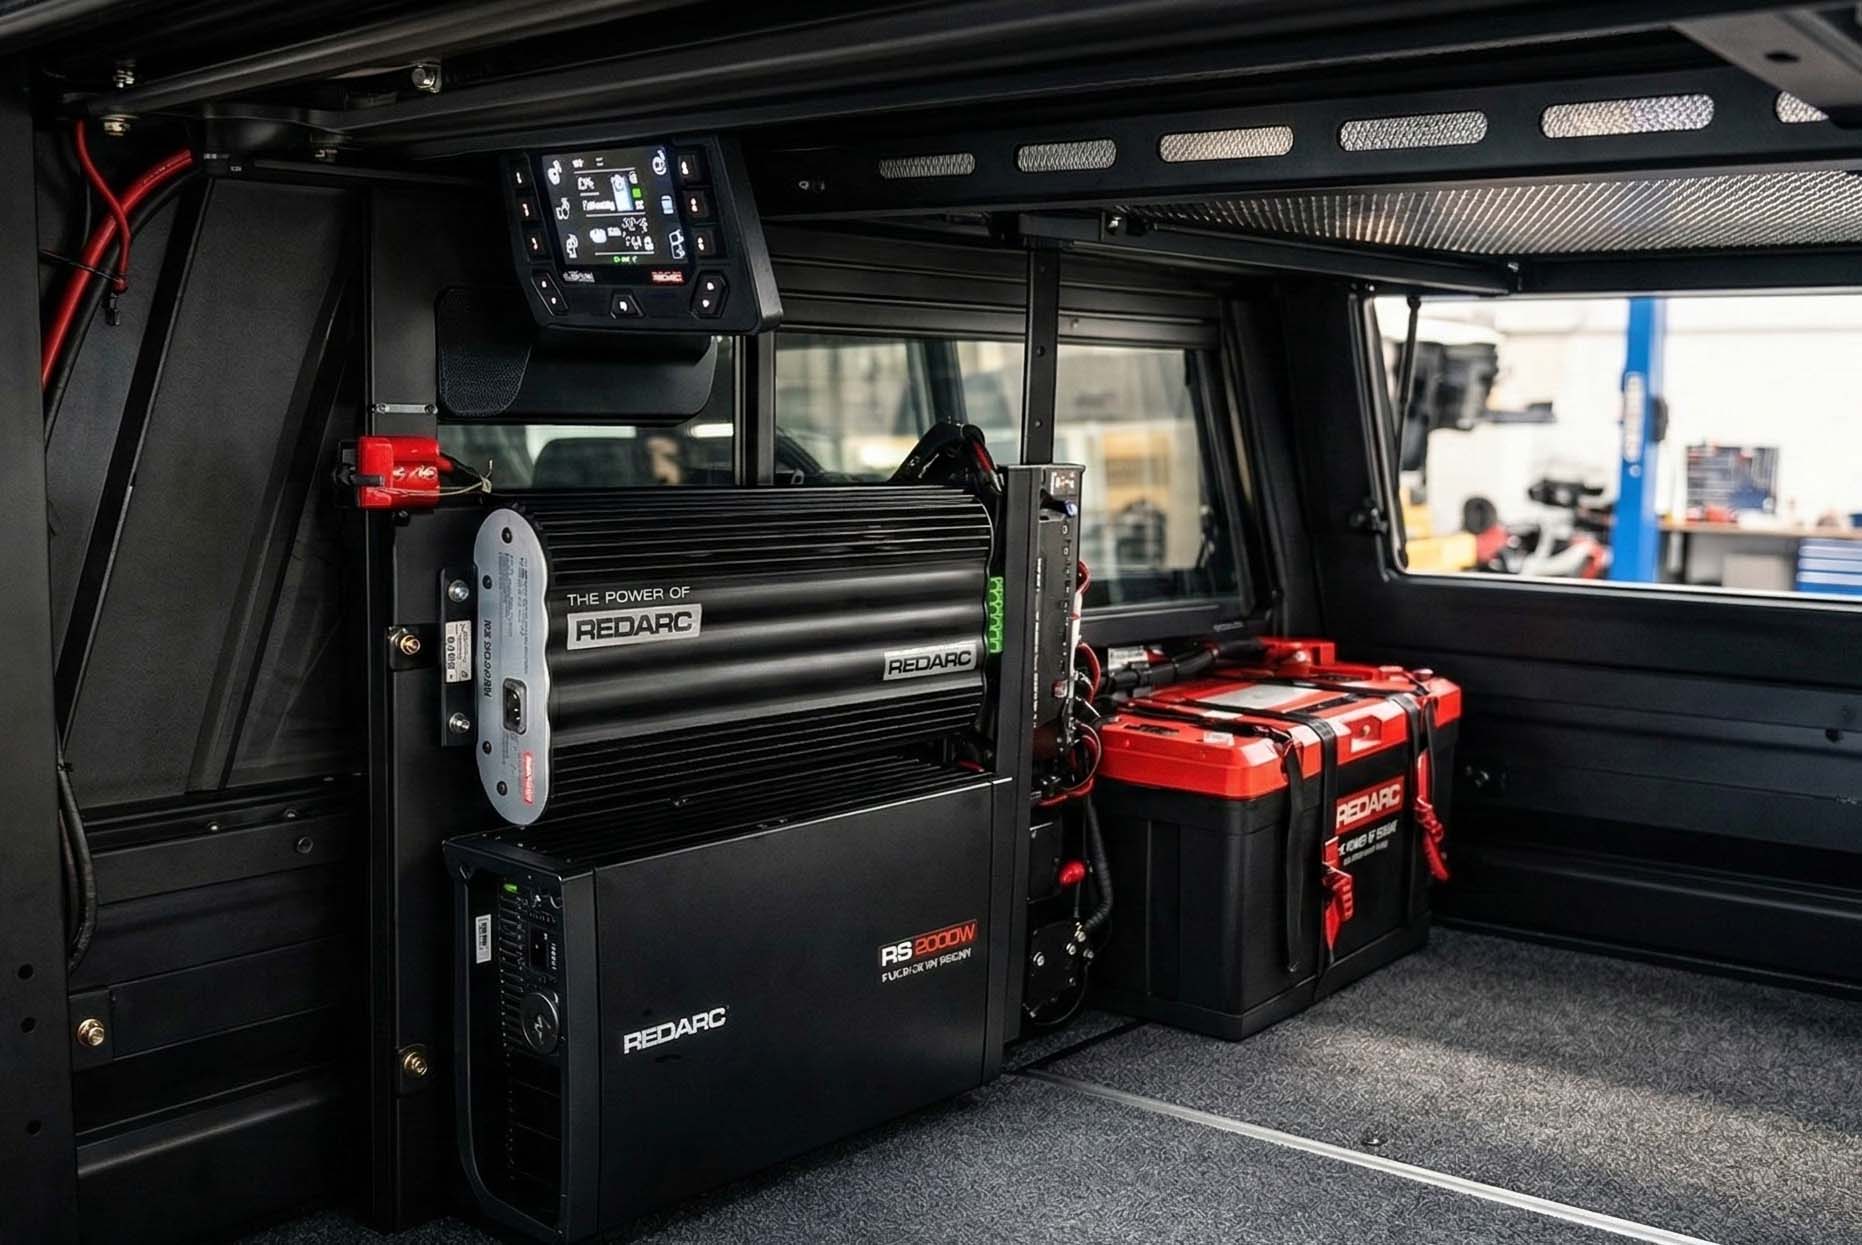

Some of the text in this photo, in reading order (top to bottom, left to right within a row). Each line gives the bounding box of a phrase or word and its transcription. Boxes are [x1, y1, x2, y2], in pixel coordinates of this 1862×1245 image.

[567, 586, 690, 606] THE POWER OF
[576, 611, 692, 642] REDARC
[887, 650, 972, 675] REDARC
[1336, 784, 1401, 829] REDARC
[881, 941, 912, 967] RS
[623, 1007, 727, 1054] REDARC
